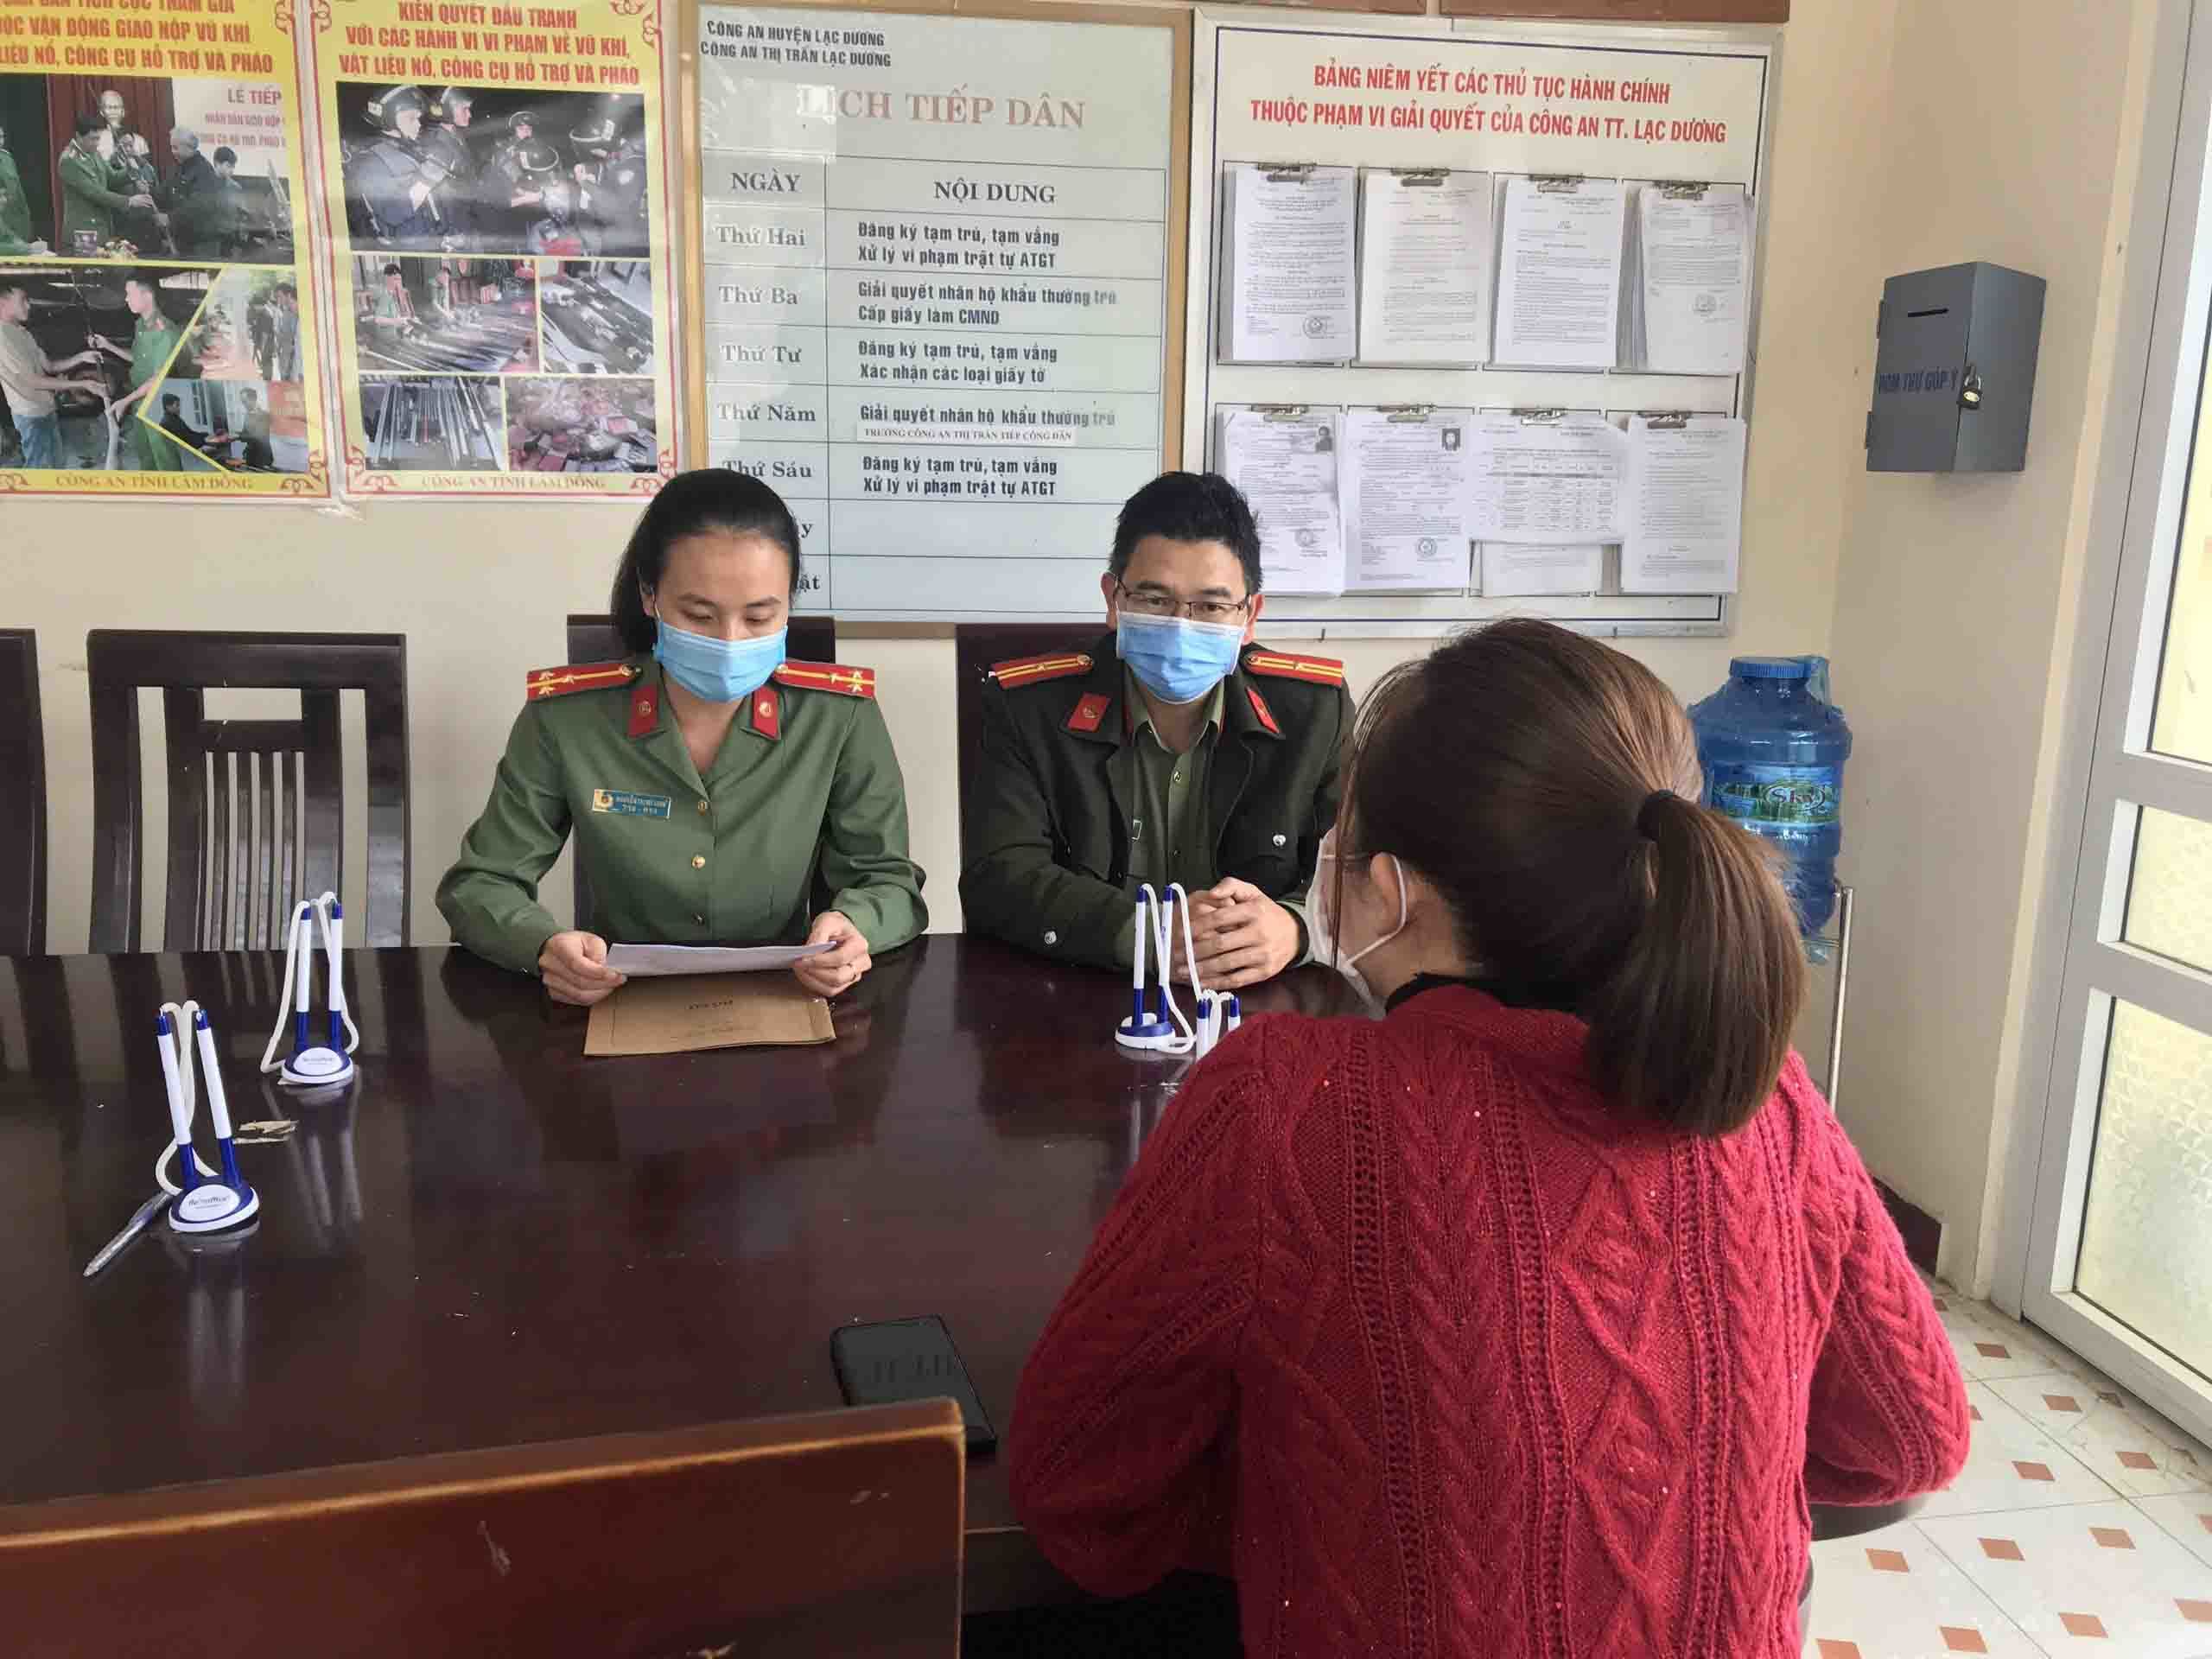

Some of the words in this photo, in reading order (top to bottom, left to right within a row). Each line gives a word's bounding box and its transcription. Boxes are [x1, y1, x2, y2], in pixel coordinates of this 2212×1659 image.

[117, 18, 153, 40] GIAO
[529, 8, 577, 29] TRANH
[462, 32, 478, 52] VI
[483, 33, 499, 53] VI
[707, 20, 743, 39] CÔNG
[747, 25, 764, 39] AN
[768, 26, 811, 46] HUYỆN
[815, 29, 839, 47] LẠC
[843, 30, 885, 47] DƯƠNG
[65, 42, 110, 67] CÔNG
[701, 40, 736, 58] CÔNG
[741, 46, 758, 59] AN
[762, 46, 782, 64] THỊ
[785, 45, 818, 63] TRẤN
[823, 50, 847, 67] LẠC
[849, 50, 892, 67] DƯƠNG
[442, 56, 485, 80] CÔNG
[489, 61, 509, 85] CỤ
[540, 61, 569, 86] TRỢ
[575, 62, 594, 84] VÀ
[1314, 56, 1362, 89] BẢNG
[1366, 62, 1411, 91] NIÊM
[1417, 61, 1450, 92] YẾT
[1454, 66, 1489, 94] CÁC
[1493, 67, 1528, 97] THỦ
[1533, 76, 1565, 103] TỤC
[1570, 73, 1615, 102] HÀNH
[1620, 77, 1670, 105] CHÍNH
[906, 82, 995, 125] TIẾP
[1006, 91, 1086, 130] DÂN
[1251, 93, 1308, 128] THUỘC
[1313, 102, 1363, 130] PHẠM
[1368, 105, 1385, 127] VI
[1390, 99, 1424, 129] GIẢI
[1429, 100, 1485, 134] QUYẾT
[1491, 103, 1523, 132] CỦA
[1529, 109, 1573, 137] CÔNG
[1577, 117, 1599, 138] AN
[1604, 118, 1629, 140] TT.
[1634, 118, 1666, 145] LẠC
[1670, 117, 1726, 144] DƯƠNG
[730, 167, 802, 194] NGÀY
[934, 175, 982, 204] NỘI
[988, 182, 1056, 204] DUNG
[714, 223, 761, 245] Thứ
[767, 226, 806, 247] Hai
[858, 221, 895, 241] Đăng
[899, 224, 917, 241] ký
[924, 226, 952, 245] tạm
[957, 226, 986, 245] trú,
[992, 228, 1020, 247] tạm
[1025, 226, 1060, 246] vắng
[858, 245, 877, 262] Xử
[883, 246, 895, 264] lý
[902, 248, 914, 263] vi
[919, 248, 959, 269] phạm
[964, 250, 994, 270] trật
[1000, 251, 1016, 271] tự
[1020, 251, 1057, 270] ATGT
[719, 283, 763, 304] Thứ
[771, 286, 799, 306] Ba
[858, 279, 887, 299] Giải
[891, 282, 935, 301] quyết
[938, 283, 974, 302] nhân
[978, 286, 996, 305] hộ
[1001, 283, 1037, 303] khẩu
[1041, 288, 1091, 308] thường
[858, 302, 886, 324] Cấp
[891, 304, 922, 325] giấy
[927, 307, 954, 324] làm
[958, 308, 1001, 326] CMND
[721, 344, 766, 363] Thứ
[772, 345, 803, 364] Tư
[858, 340, 895, 359] Đăng
[899, 341, 917, 359] ký
[924, 343, 952, 362] tạm
[957, 343, 985, 361] trú,
[991, 345, 1019, 364] tạm
[1023, 340, 1058, 364] vắng
[861, 363, 888, 380] Xác
[893, 364, 928, 385] nhận
[932, 365, 960, 382] các
[964, 365, 991, 385] loại
[995, 366, 1026, 385] giấy
[1032, 366, 1046, 384] tờ
[717, 403, 761, 421] Thứ
[767, 404, 817, 423] Năm
[861, 403, 888, 422] Giải
[893, 404, 936, 424] quyết
[940, 406, 974, 424] nhân
[977, 407, 995, 426] hộ
[1001, 404, 1037, 426] khẩu
[1041, 408, 1090, 428] thường
[772, 460, 812, 478] Sáu
[863, 456, 899, 474] Đăng
[904, 456, 920, 475] ký
[927, 458, 955, 476] tạm
[960, 458, 988, 475] trú,
[992, 459, 1019, 478] tạm
[1024, 456, 1058, 477] vắng
[864, 476, 882, 493] Xử
[887, 477, 899, 495] lý
[906, 479, 918, 493] vi
[924, 480, 962, 499] phạm
[967, 480, 996, 499] trật
[1001, 480, 1017, 499] tự
[1021, 480, 1057, 497] ATGT
